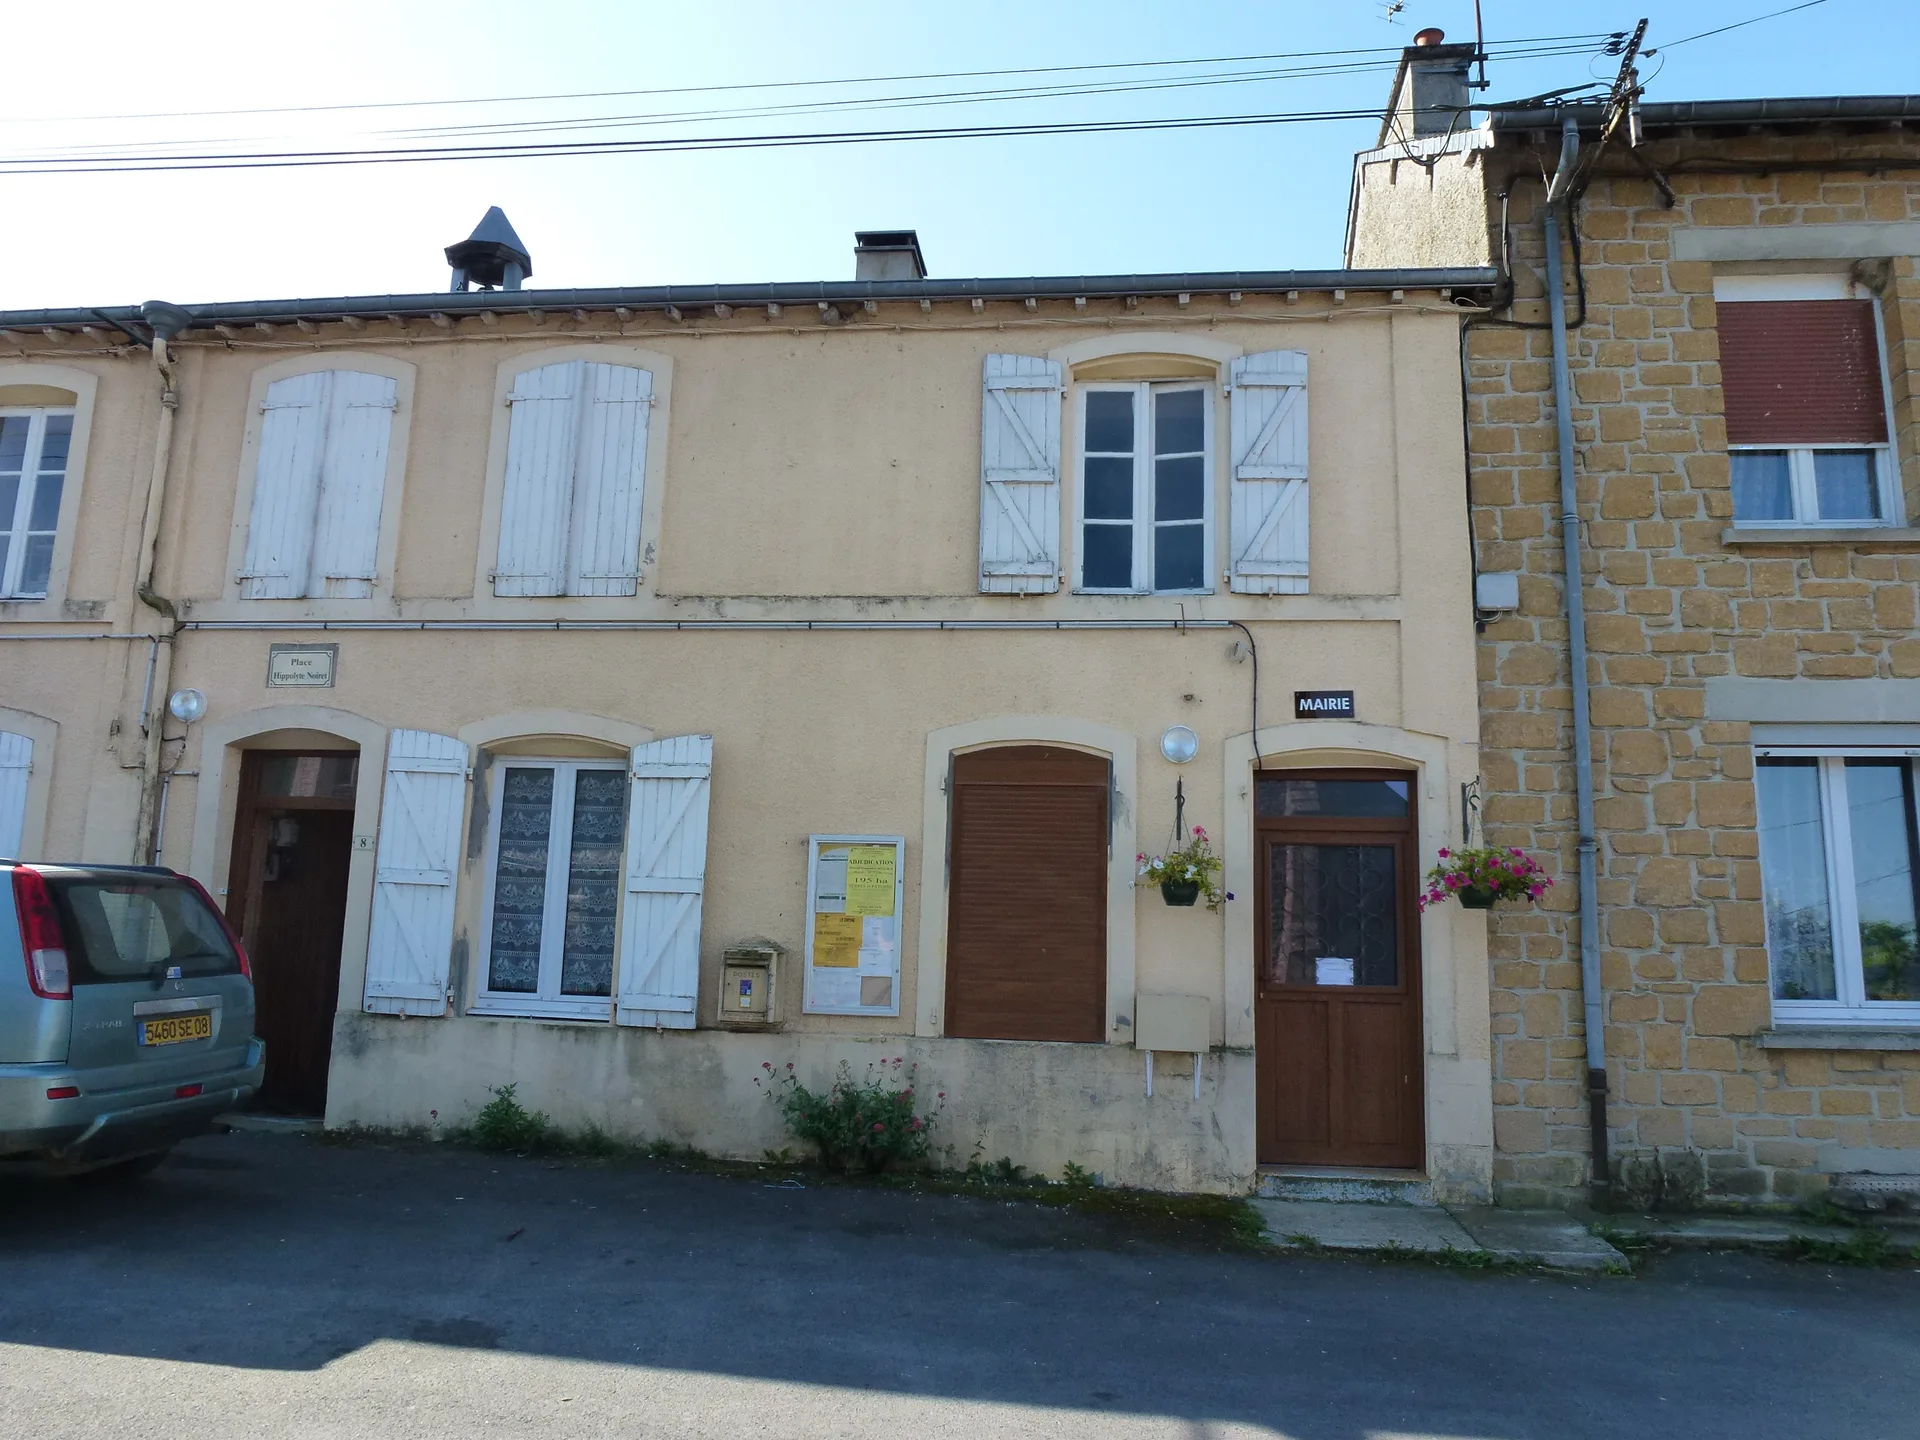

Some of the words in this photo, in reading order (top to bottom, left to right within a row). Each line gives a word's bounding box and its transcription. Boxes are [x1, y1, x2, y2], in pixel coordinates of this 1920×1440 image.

[291, 658, 312, 666] Place
[273, 671, 305, 682] Hippolyte
[307, 671, 327, 680] Noiret
[1299, 697, 1350, 711] MAIRIE
[359, 837, 367, 848] 8
[145, 1022, 177, 1041] 5460
[179, 1018, 193, 1037] SE
[194, 1017, 208, 1034] 08
